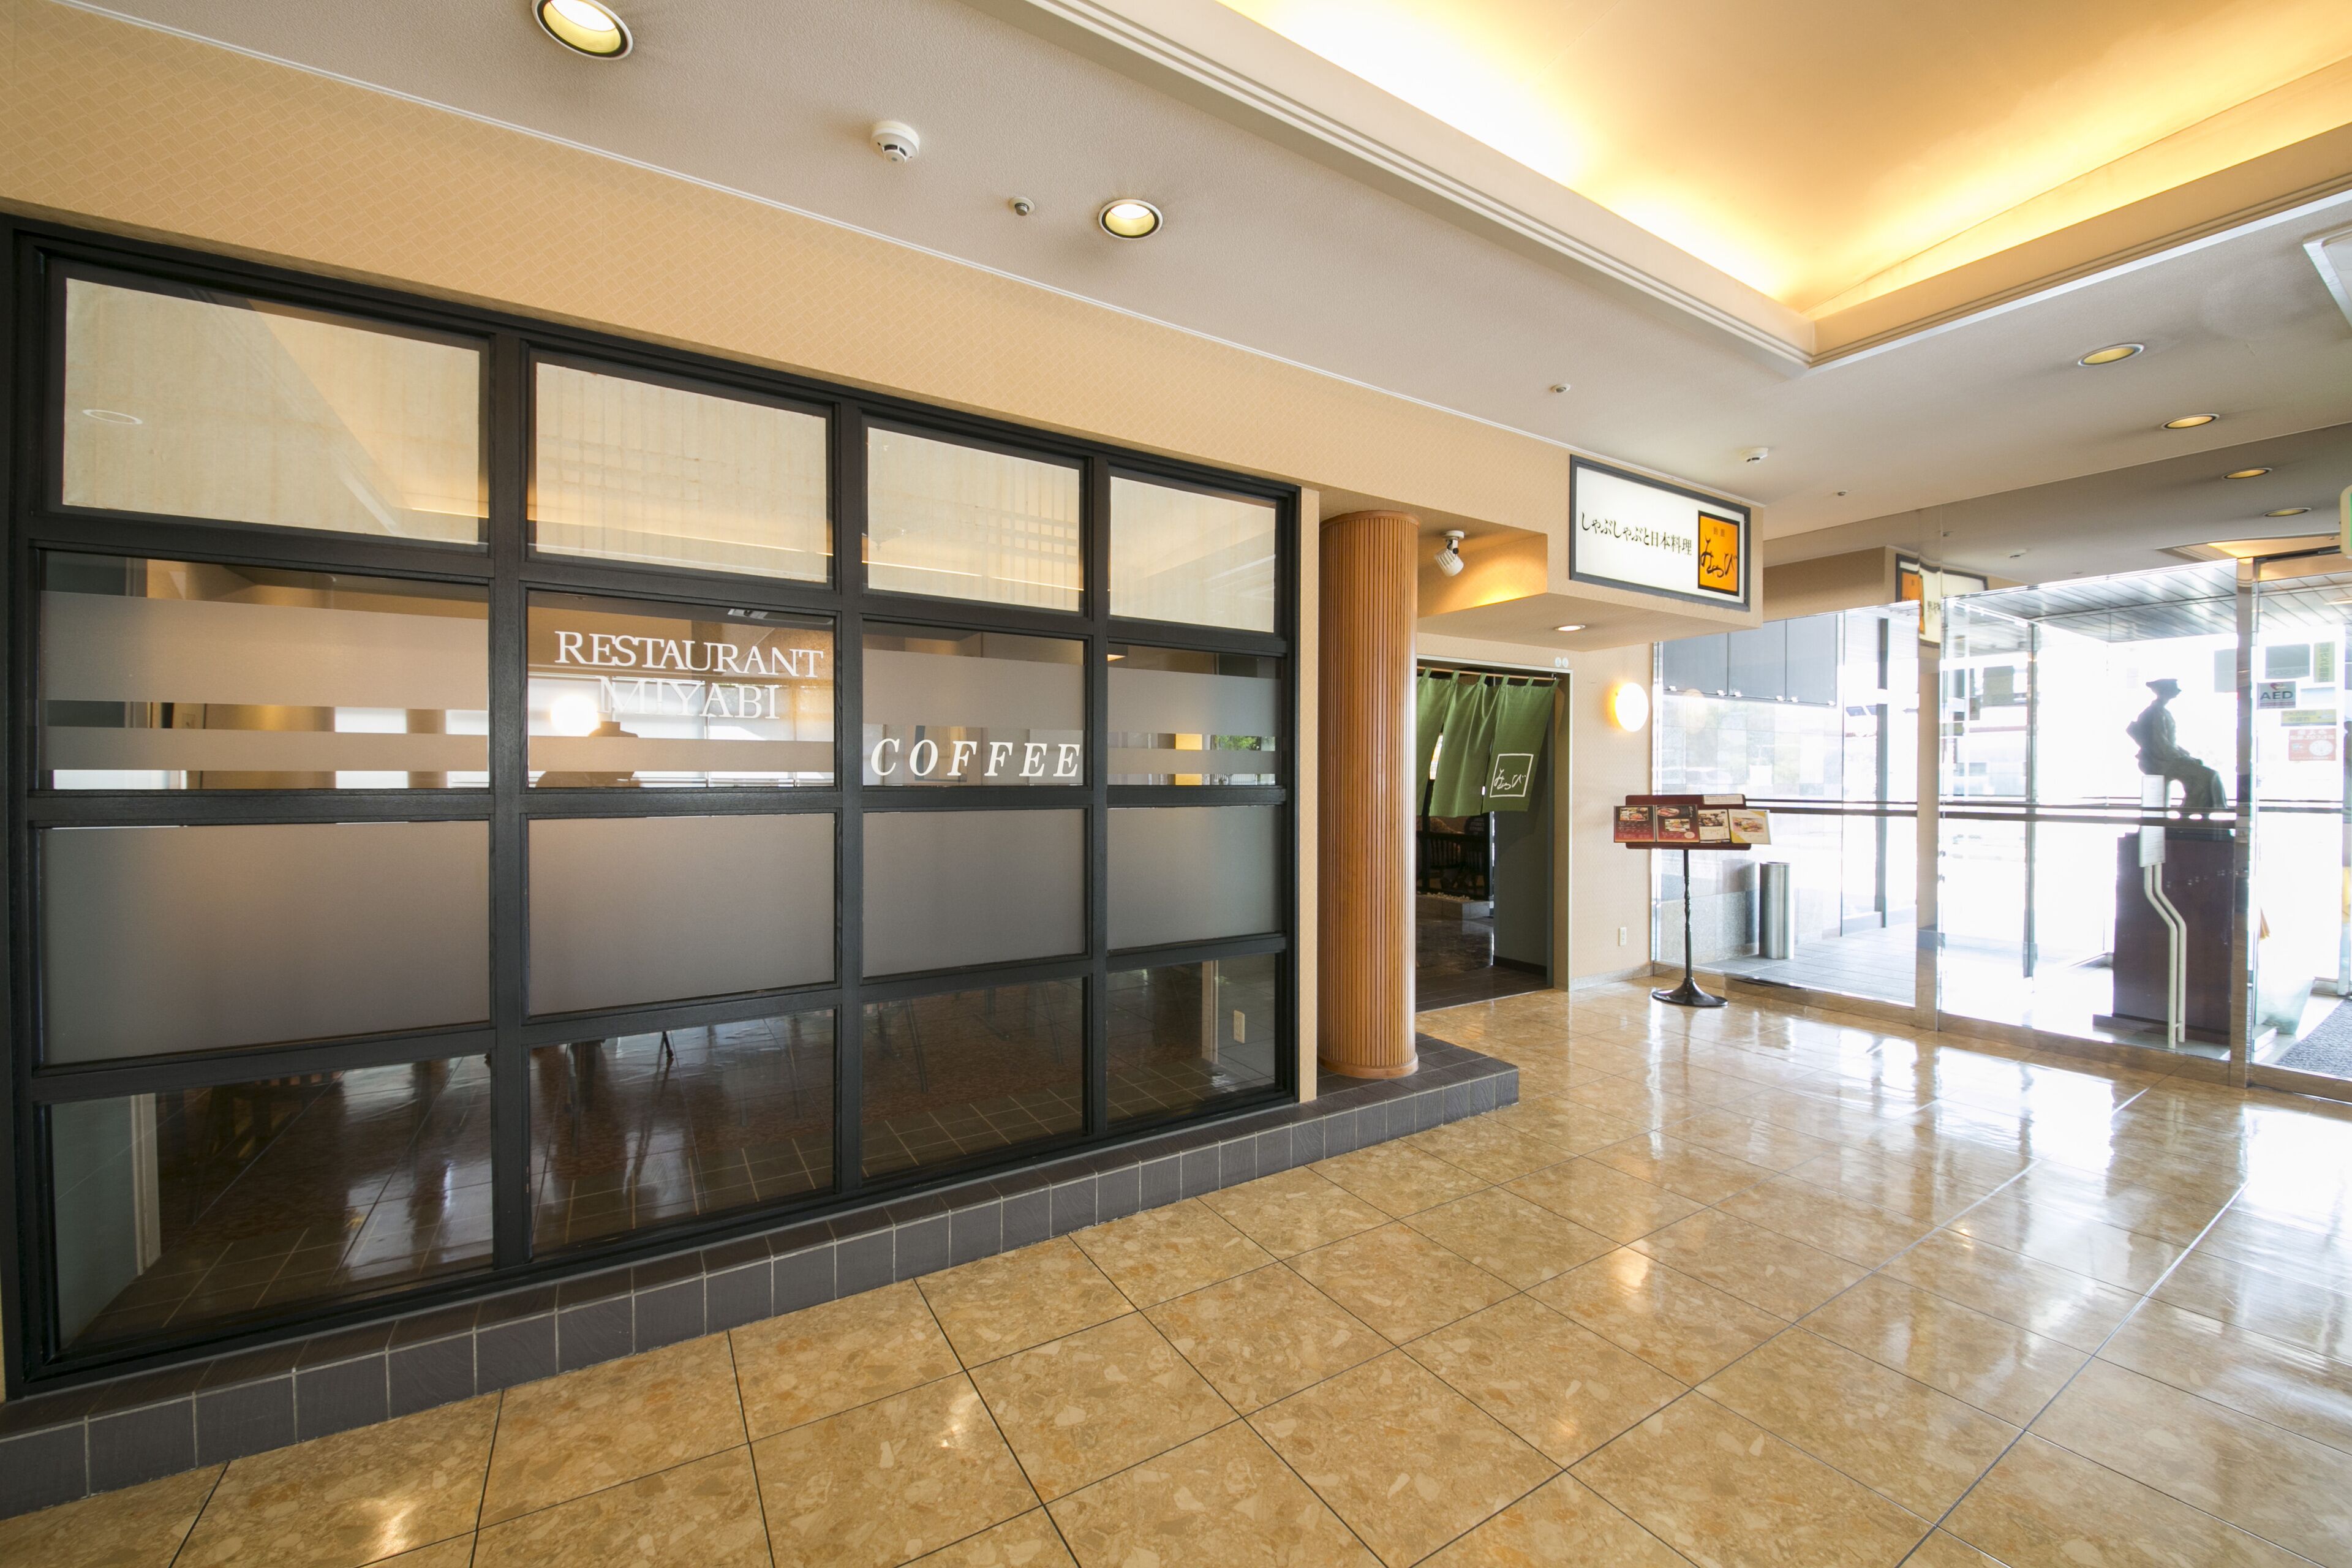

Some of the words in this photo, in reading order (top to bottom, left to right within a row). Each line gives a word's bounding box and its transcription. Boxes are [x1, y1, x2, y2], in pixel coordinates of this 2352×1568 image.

[1581, 512, 1692, 556] しゃぶしゃぶと日本料理
[554, 630, 824, 678] RESTAURANT
[595, 676, 780, 720] MIYABI
[2260, 691, 2294, 700] AED
[870, 738, 1081, 777] COFFEE
